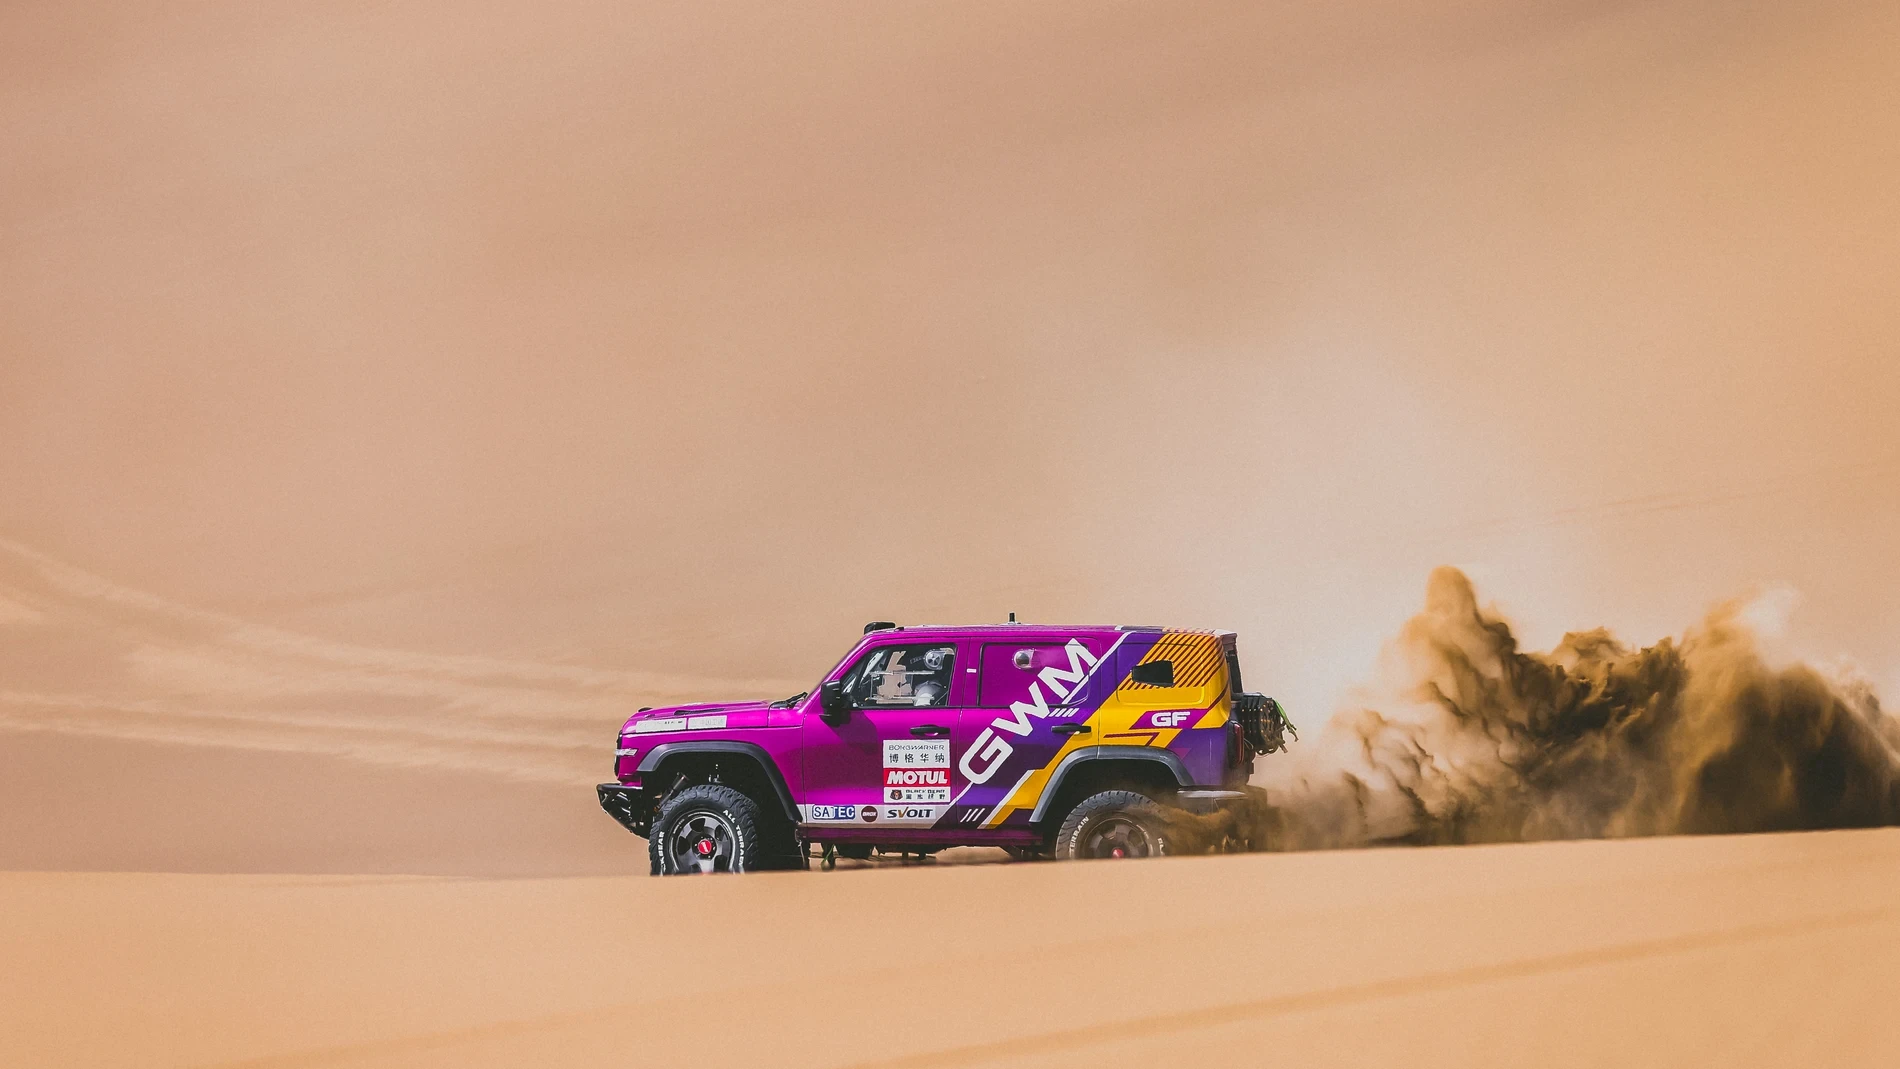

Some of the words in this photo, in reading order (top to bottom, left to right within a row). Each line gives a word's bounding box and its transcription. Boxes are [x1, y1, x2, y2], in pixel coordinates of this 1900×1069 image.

[958, 638, 1098, 784] GWM
[1151, 711, 1190, 727] GF
[889, 752, 945, 763] 博格华纳
[886, 770, 948, 785] MOTUL
[722, 809, 736, 824] ALL
[814, 806, 855, 818] SATEC
[886, 806, 933, 818] SVOLT
